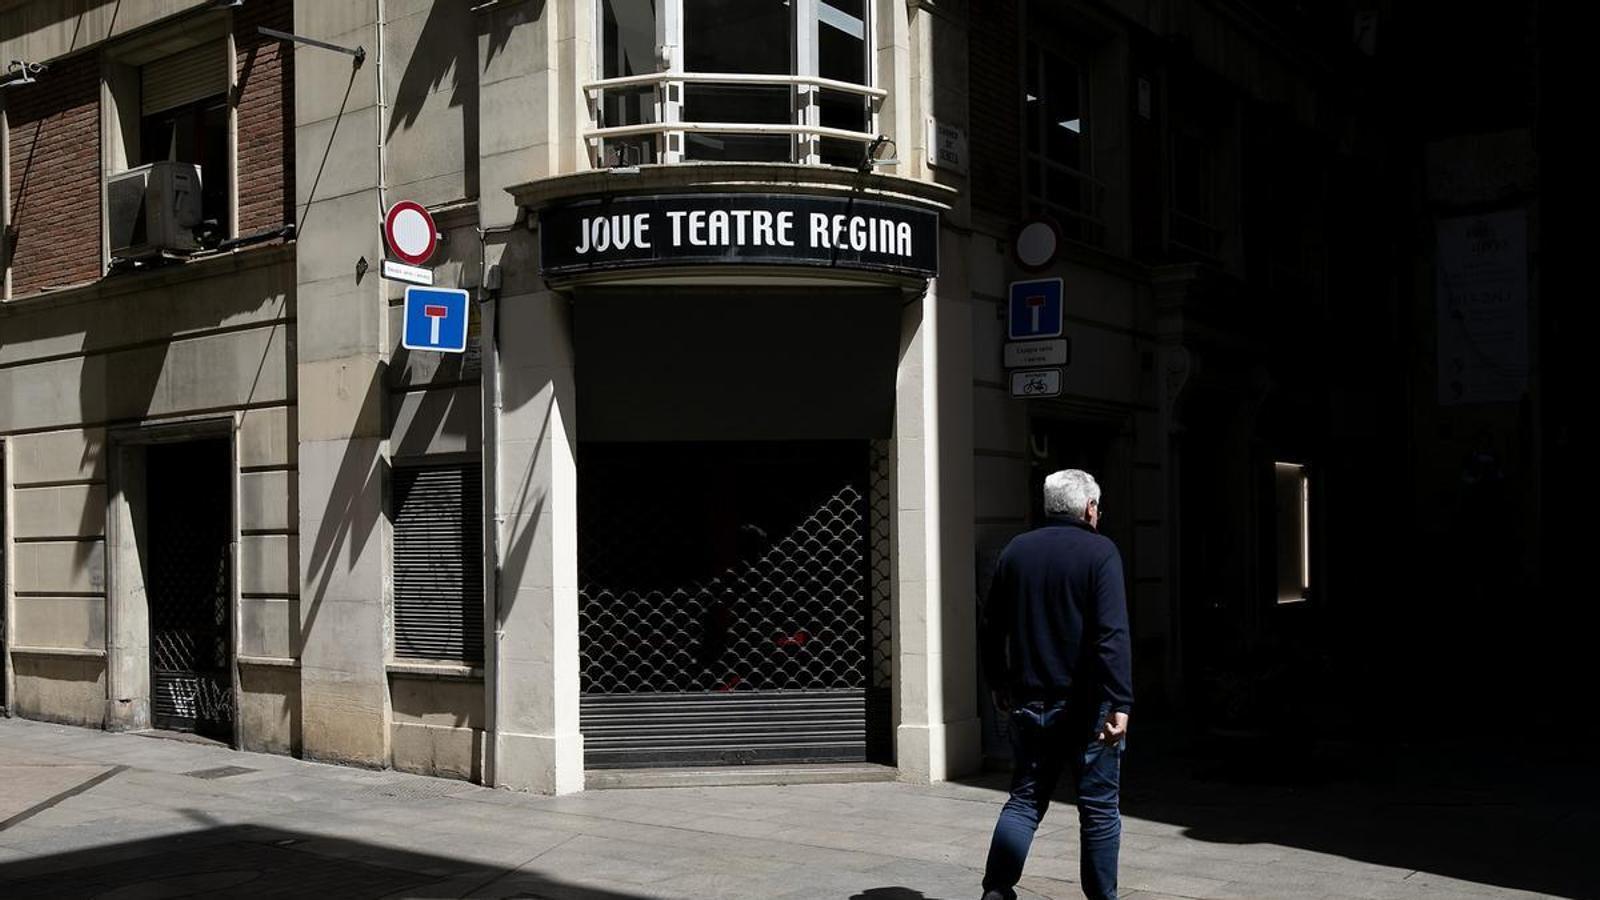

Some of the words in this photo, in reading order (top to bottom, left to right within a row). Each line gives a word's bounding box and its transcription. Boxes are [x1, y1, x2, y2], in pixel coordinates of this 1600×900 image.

[575, 213, 651, 253] JOVE
[666, 210, 794, 247] TEATRE
[810, 212, 912, 257] REGINA
